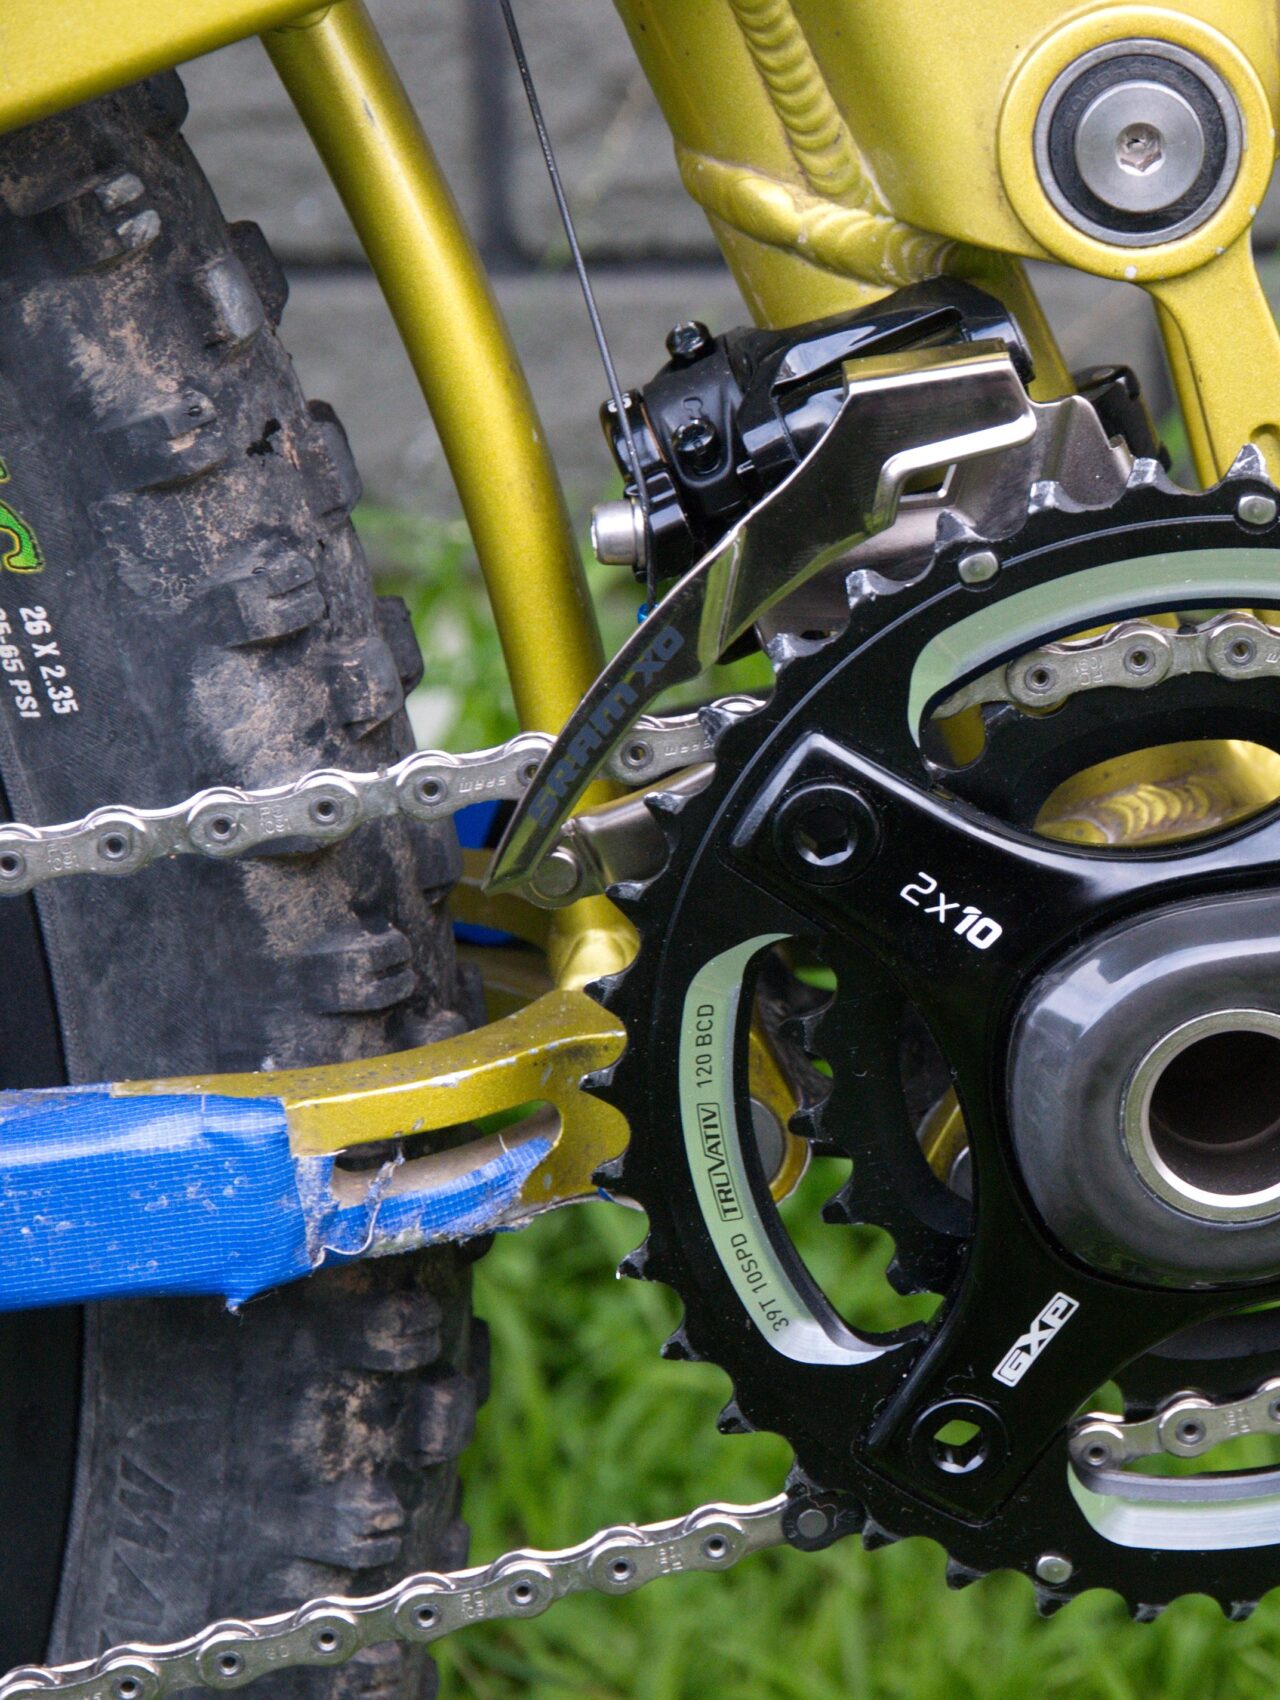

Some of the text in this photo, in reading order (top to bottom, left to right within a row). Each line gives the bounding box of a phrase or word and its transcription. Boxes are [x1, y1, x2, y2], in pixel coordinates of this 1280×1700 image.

[8, 679, 41, 718] PSI
[19, 605, 51, 636] 26
[39, 664, 79, 714] 2.35
[527, 682, 639, 829] SRAM
[695, 1003, 790, 1333] 39T 10SPD TRUVATIV 120 BCD
[997, 1296, 1076, 1384] GXP
